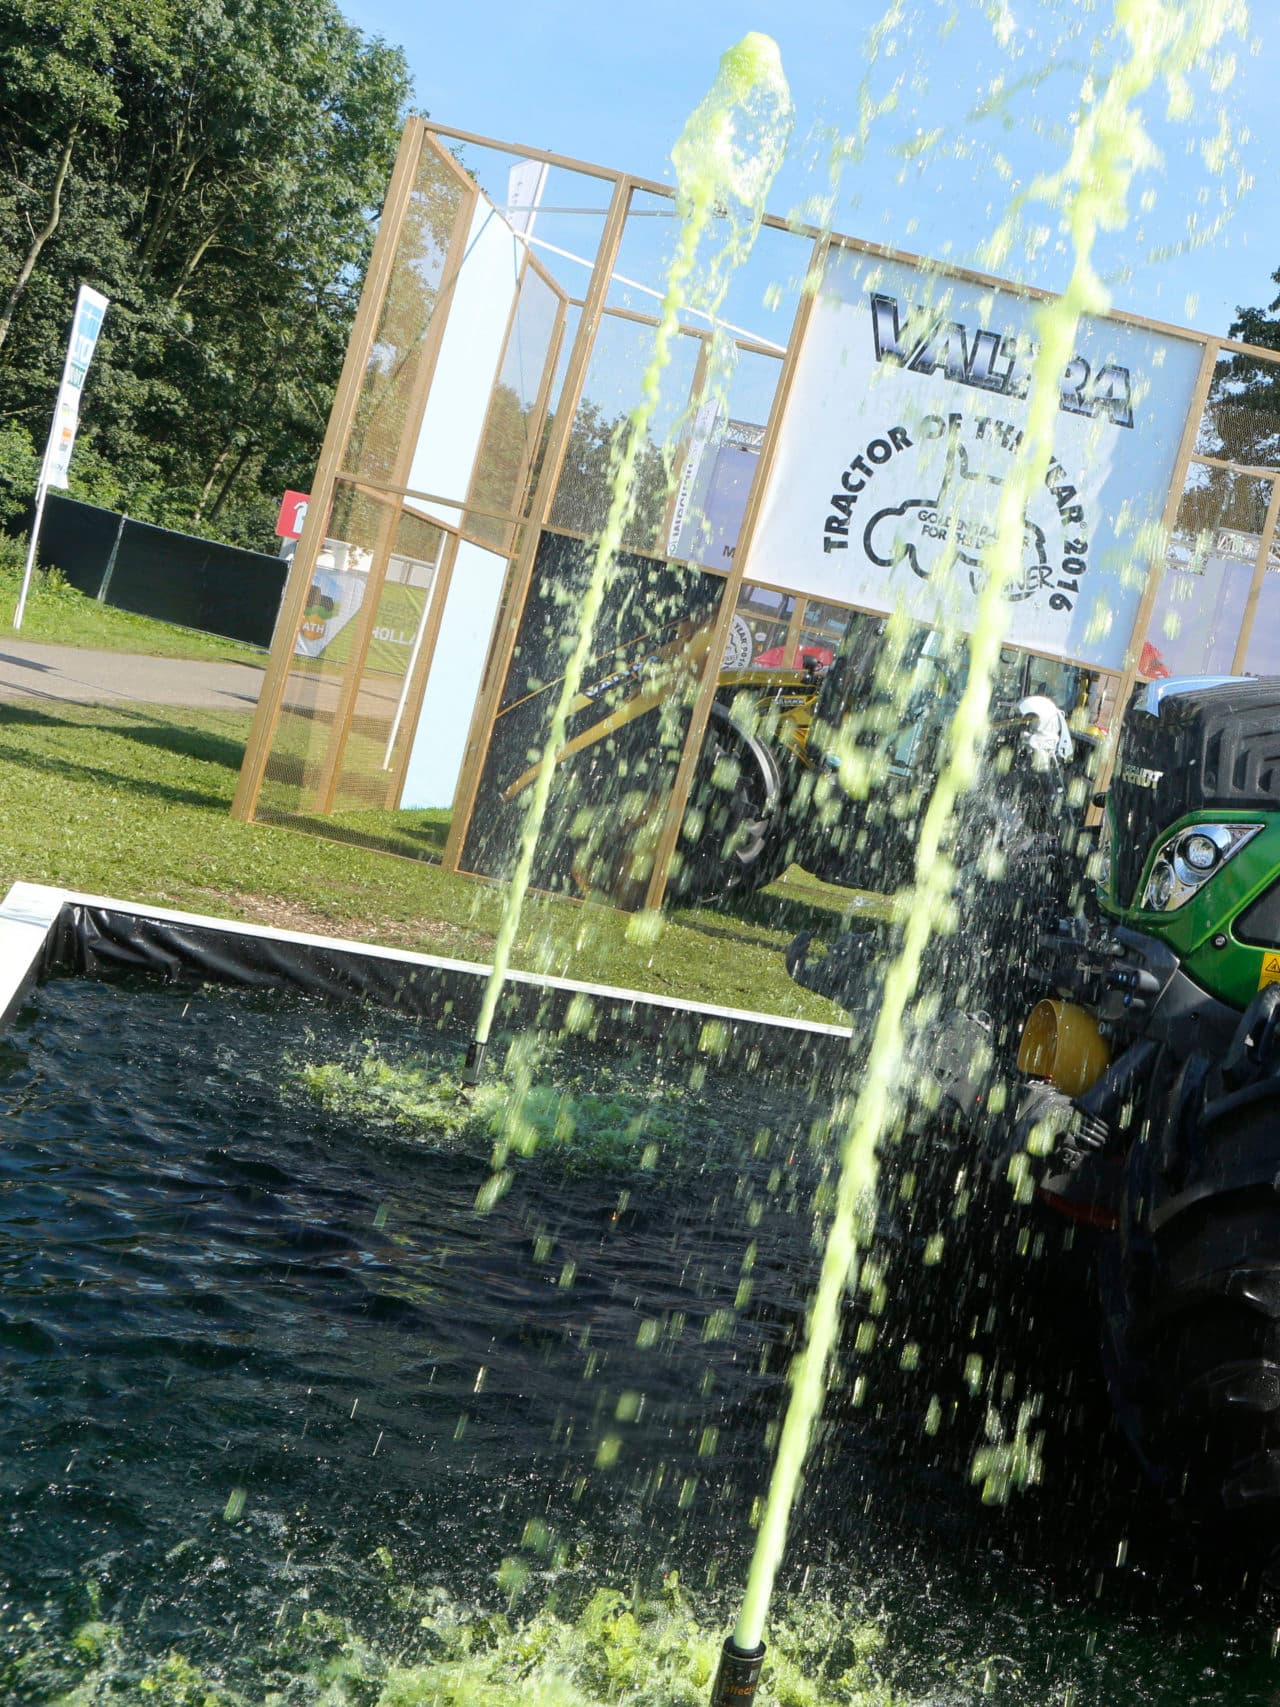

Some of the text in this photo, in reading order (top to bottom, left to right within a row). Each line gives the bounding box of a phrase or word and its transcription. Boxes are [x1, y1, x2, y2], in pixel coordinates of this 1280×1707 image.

[823, 426, 914, 553] TRACTOR
[920, 413, 963, 441] OF
[1049, 537, 1089, 612] 2016
[921, 525, 947, 541] FOR
